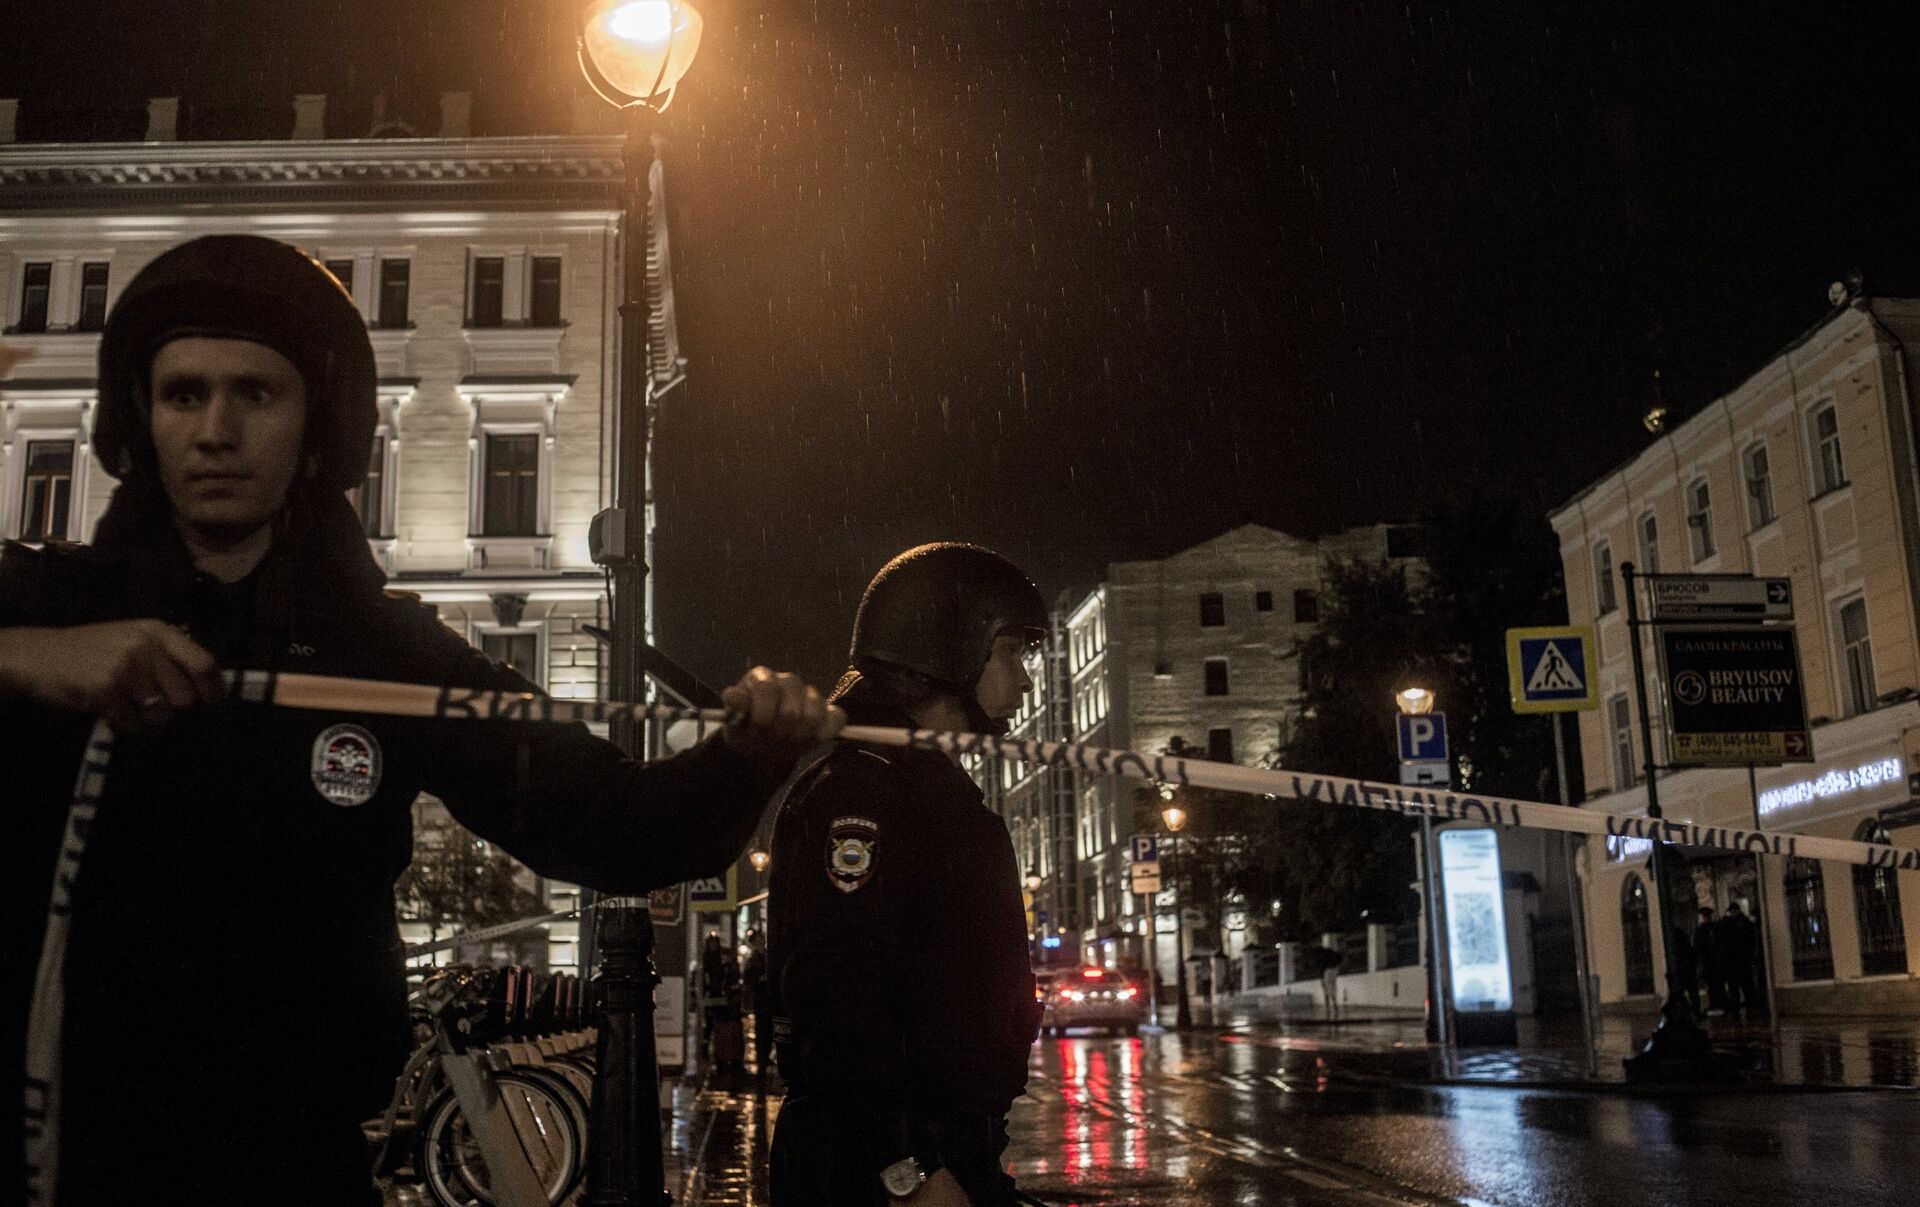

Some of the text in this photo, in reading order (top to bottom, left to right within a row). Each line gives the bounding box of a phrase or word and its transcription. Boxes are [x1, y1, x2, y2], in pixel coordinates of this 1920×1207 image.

[1658, 583, 1710, 593] БРЮСОВ
[1708, 669, 1794, 686] BRYUSOV
[1711, 688, 1785, 705] BEAUTY
[1409, 718, 1434, 757] P
[1136, 838, 1151, 860] P
